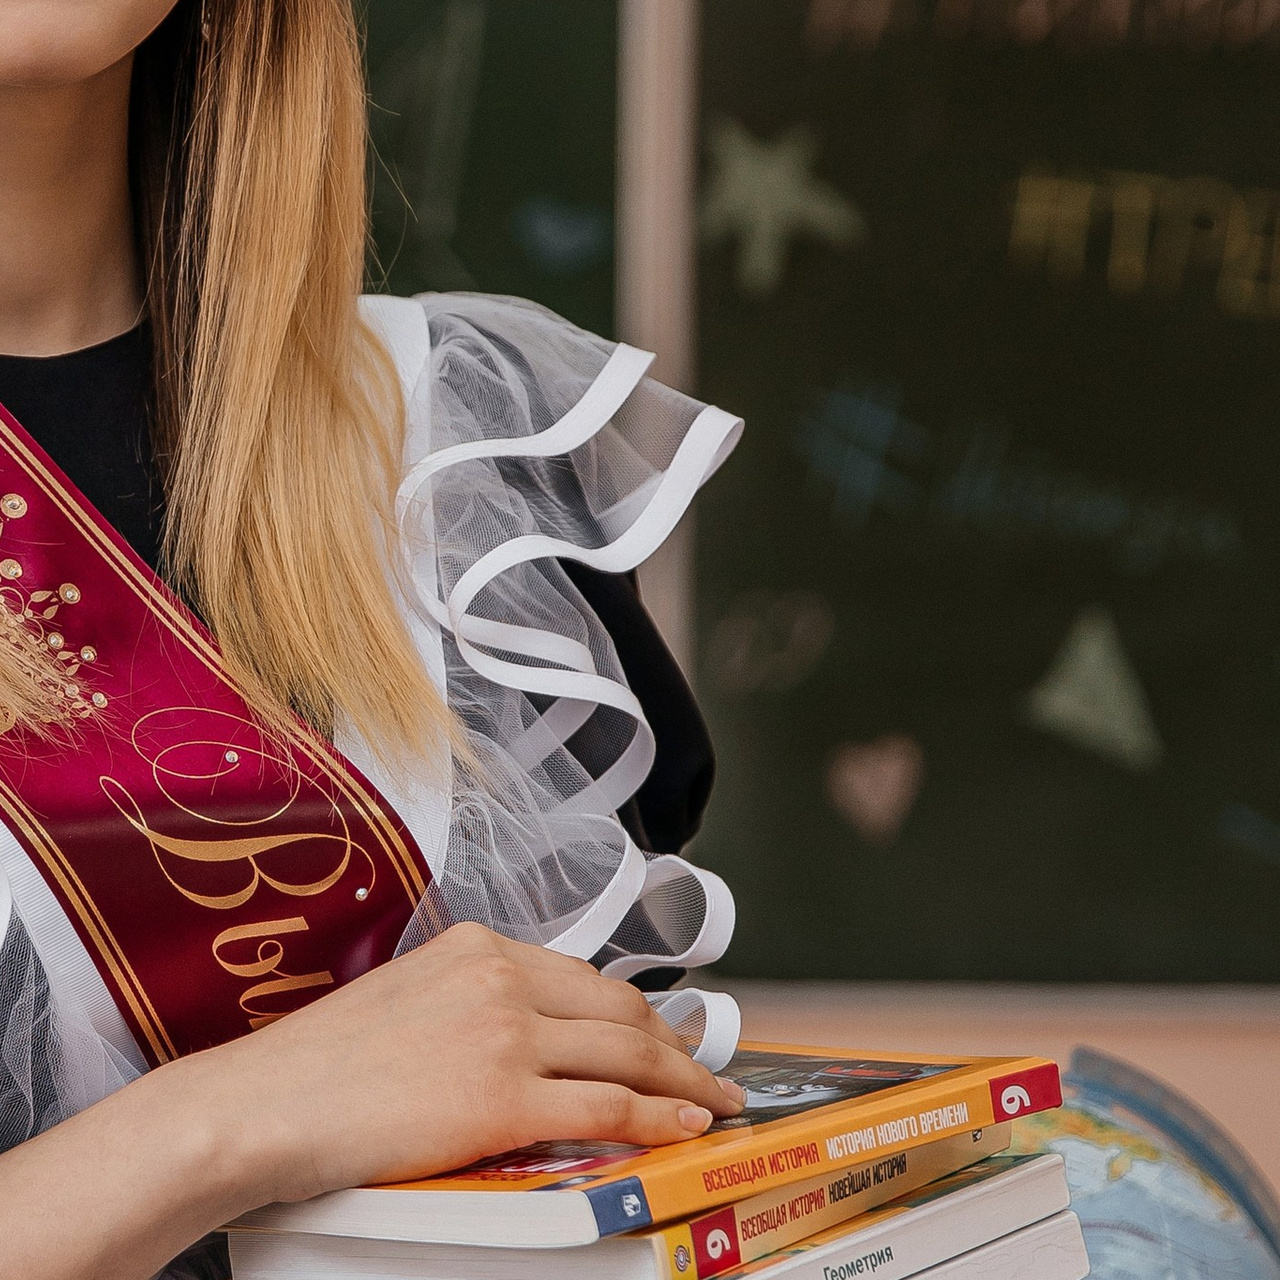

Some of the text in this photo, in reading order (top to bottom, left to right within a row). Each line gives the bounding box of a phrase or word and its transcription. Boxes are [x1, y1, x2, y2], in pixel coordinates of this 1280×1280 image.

[99, 706, 375, 1030] Вы
[826, 1102, 969, 1160] ИСТОРИЯ НОВОГО ВРЕМЕНИ
[702, 1142, 820, 1193] ВСЕОБЩАЯ ИСТОРИЯ
[828, 1152, 907, 1205] НОВЕЙШАЯ ИСТОРИЯ
[740, 1186, 827, 1242] ВСЕОБЩАЯ ИСТОРИЯ
